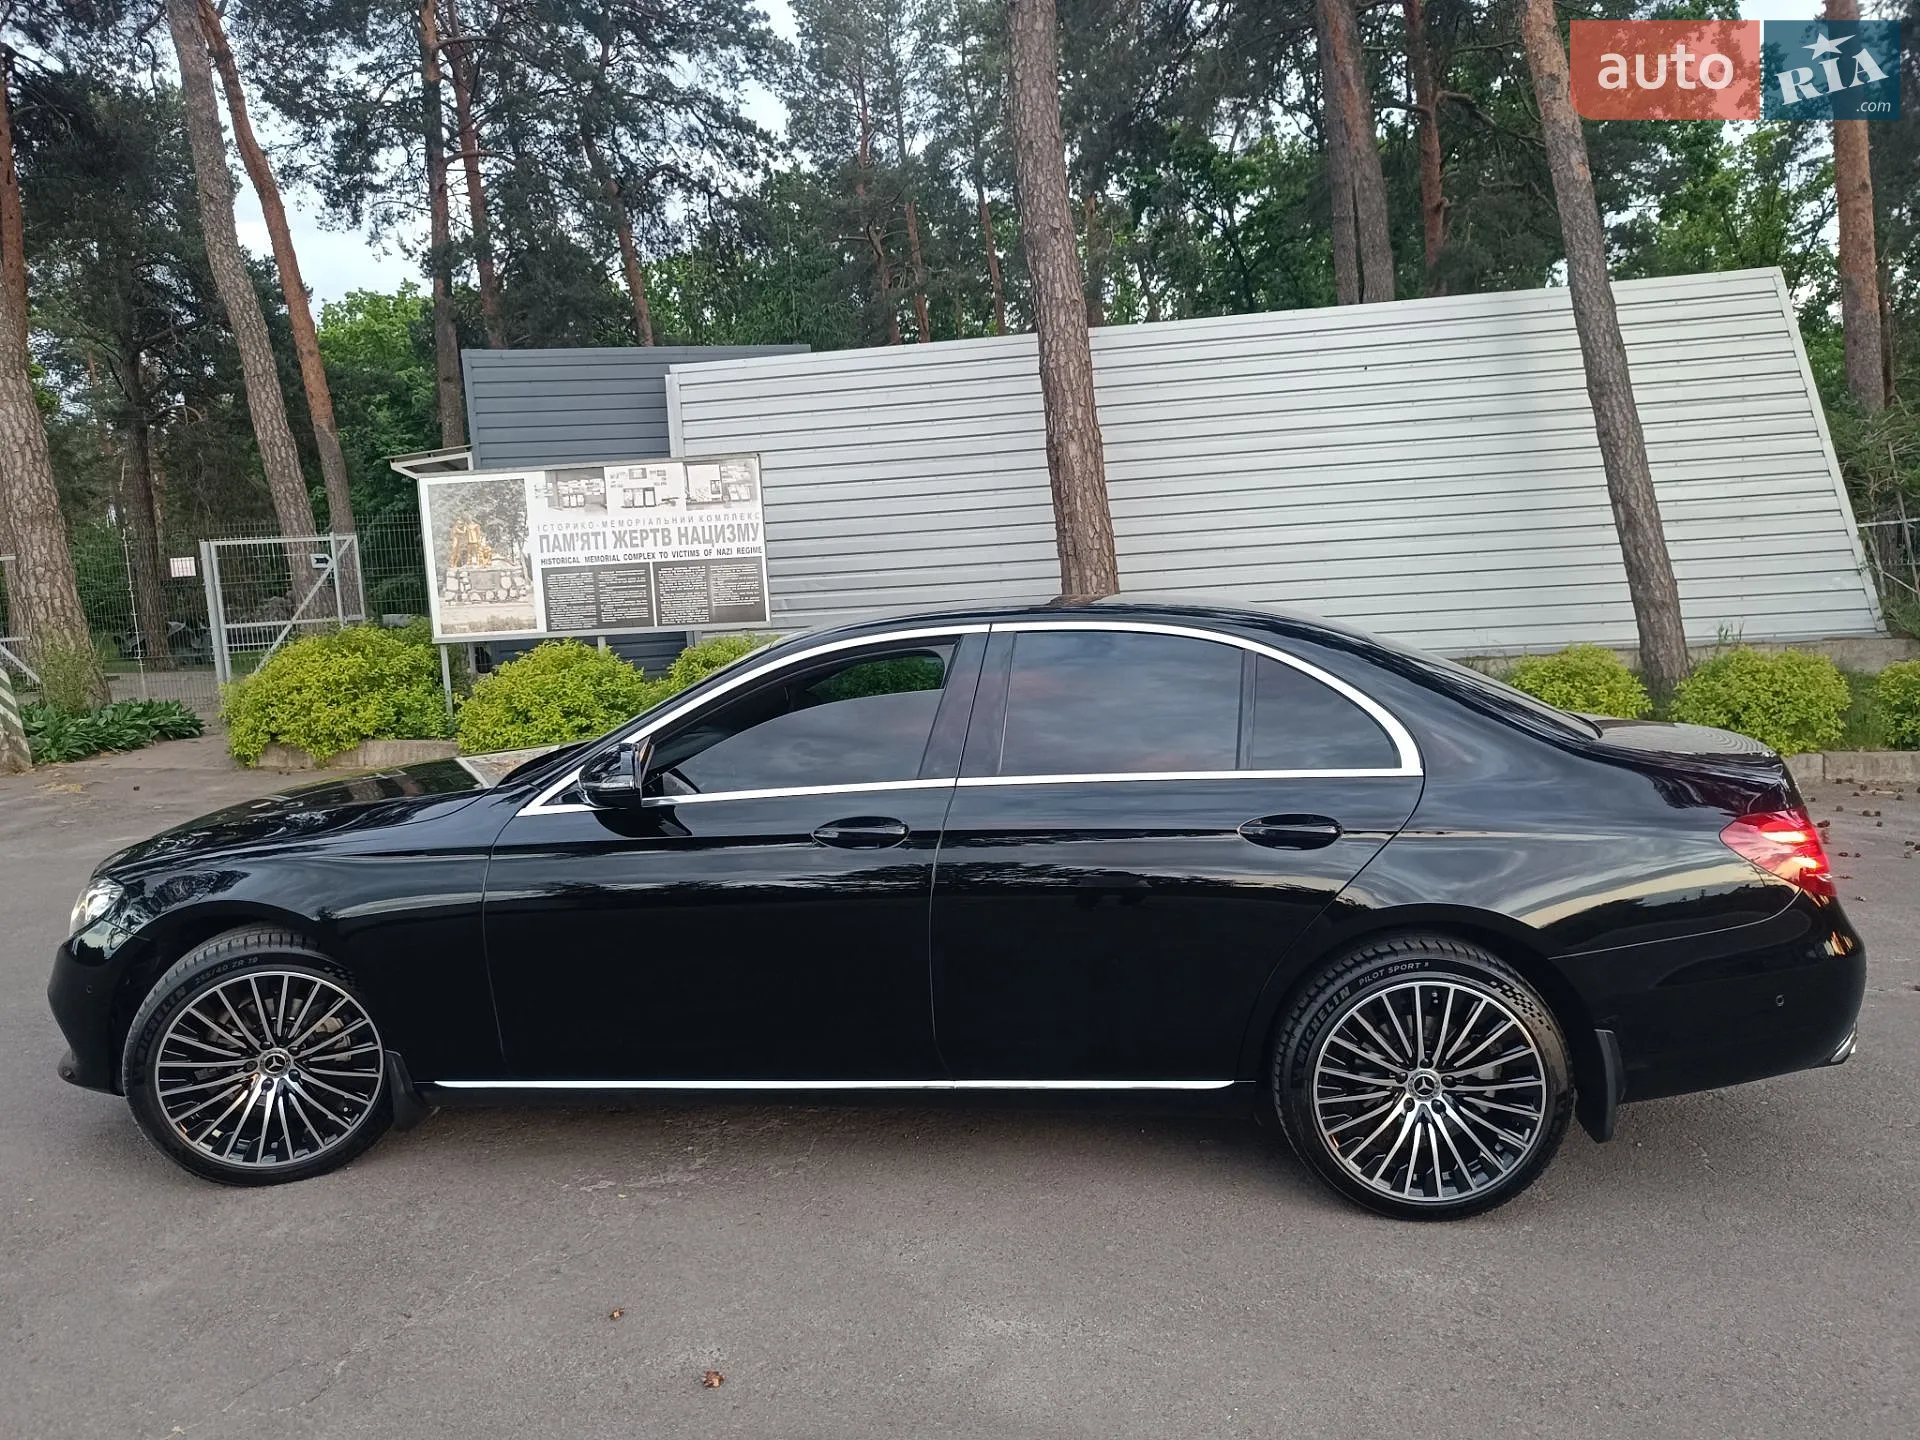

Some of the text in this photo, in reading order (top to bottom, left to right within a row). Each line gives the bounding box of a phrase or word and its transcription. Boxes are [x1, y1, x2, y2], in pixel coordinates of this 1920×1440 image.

[698, 512, 760, 523] КОМПЛЕКС
[539, 523, 760, 553] ПАМ'ЯТІ ЖЕРТВ НАЦИЗМУ
[540, 546, 763, 566] HISTORICAL MEMORIAL COMPLEX TO VICTIMS OF NAZI REGIME
[1294, 962, 1422, 1066] MICHELIN PILOT SPORT
